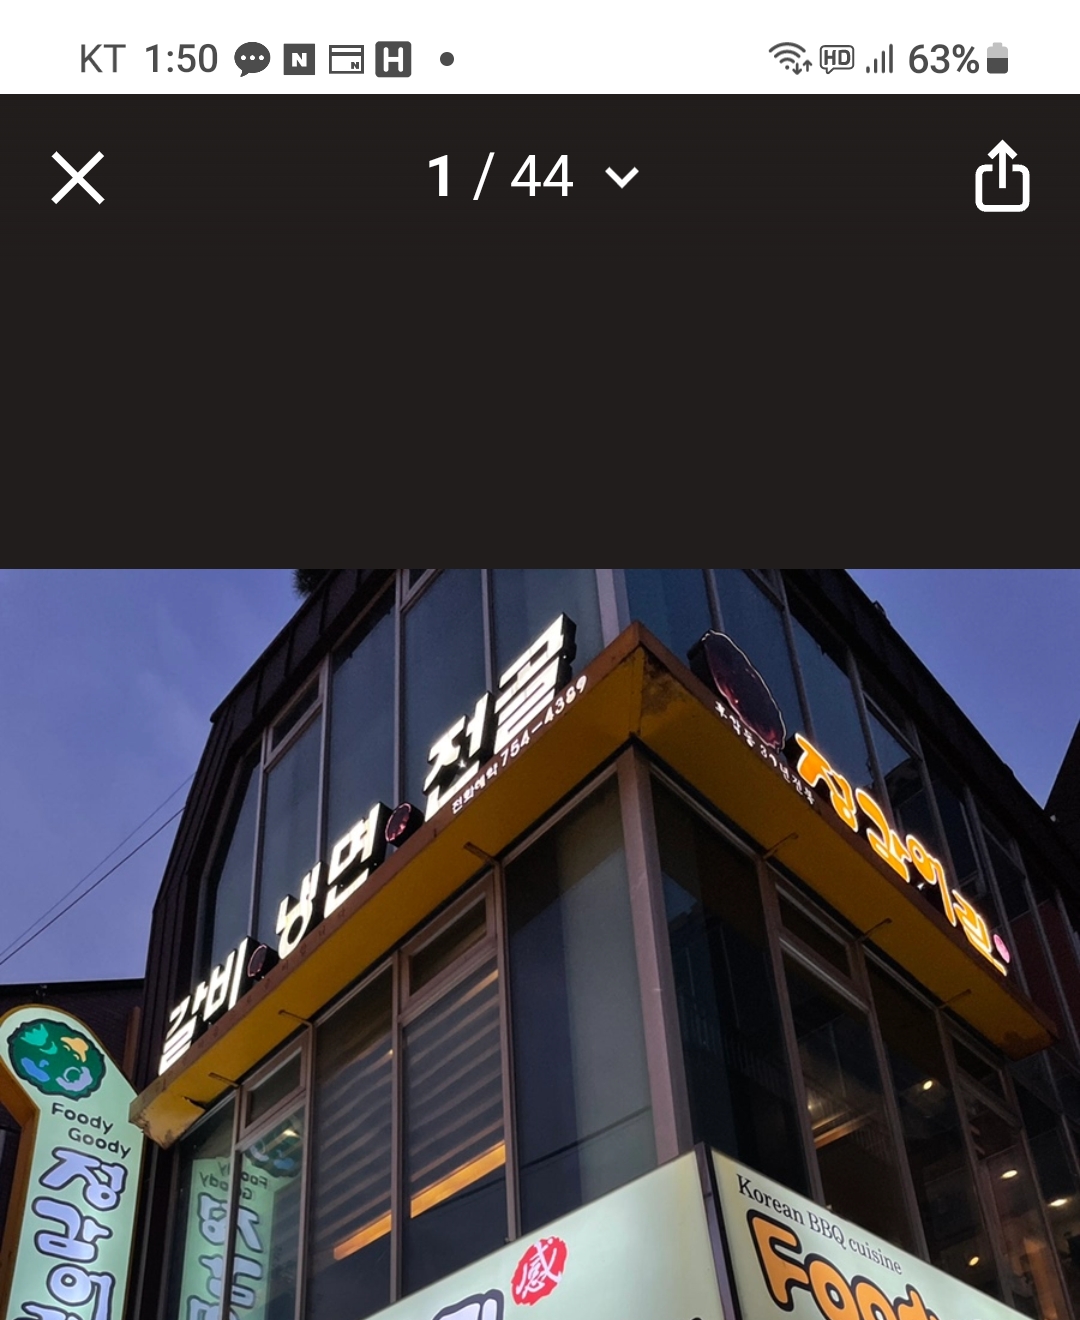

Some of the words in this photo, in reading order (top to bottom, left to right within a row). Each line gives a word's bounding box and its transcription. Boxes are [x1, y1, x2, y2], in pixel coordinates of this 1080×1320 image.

[452, 763, 498, 814] 전화예약
[500, 675, 587, 767] 754-4389
[159, 937, 249, 1076] 갈비
[276, 803, 381, 959] 냉면
[424, 612, 566, 823] 전골
[795, 732, 1008, 976] 정감어린
[51, 1102, 114, 1135] Foody
[68, 1127, 132, 1159] Goody
[736, 1174, 805, 1225] Korean
[808, 1211, 846, 1249] BBQ
[849, 1238, 902, 1275] cuisine
